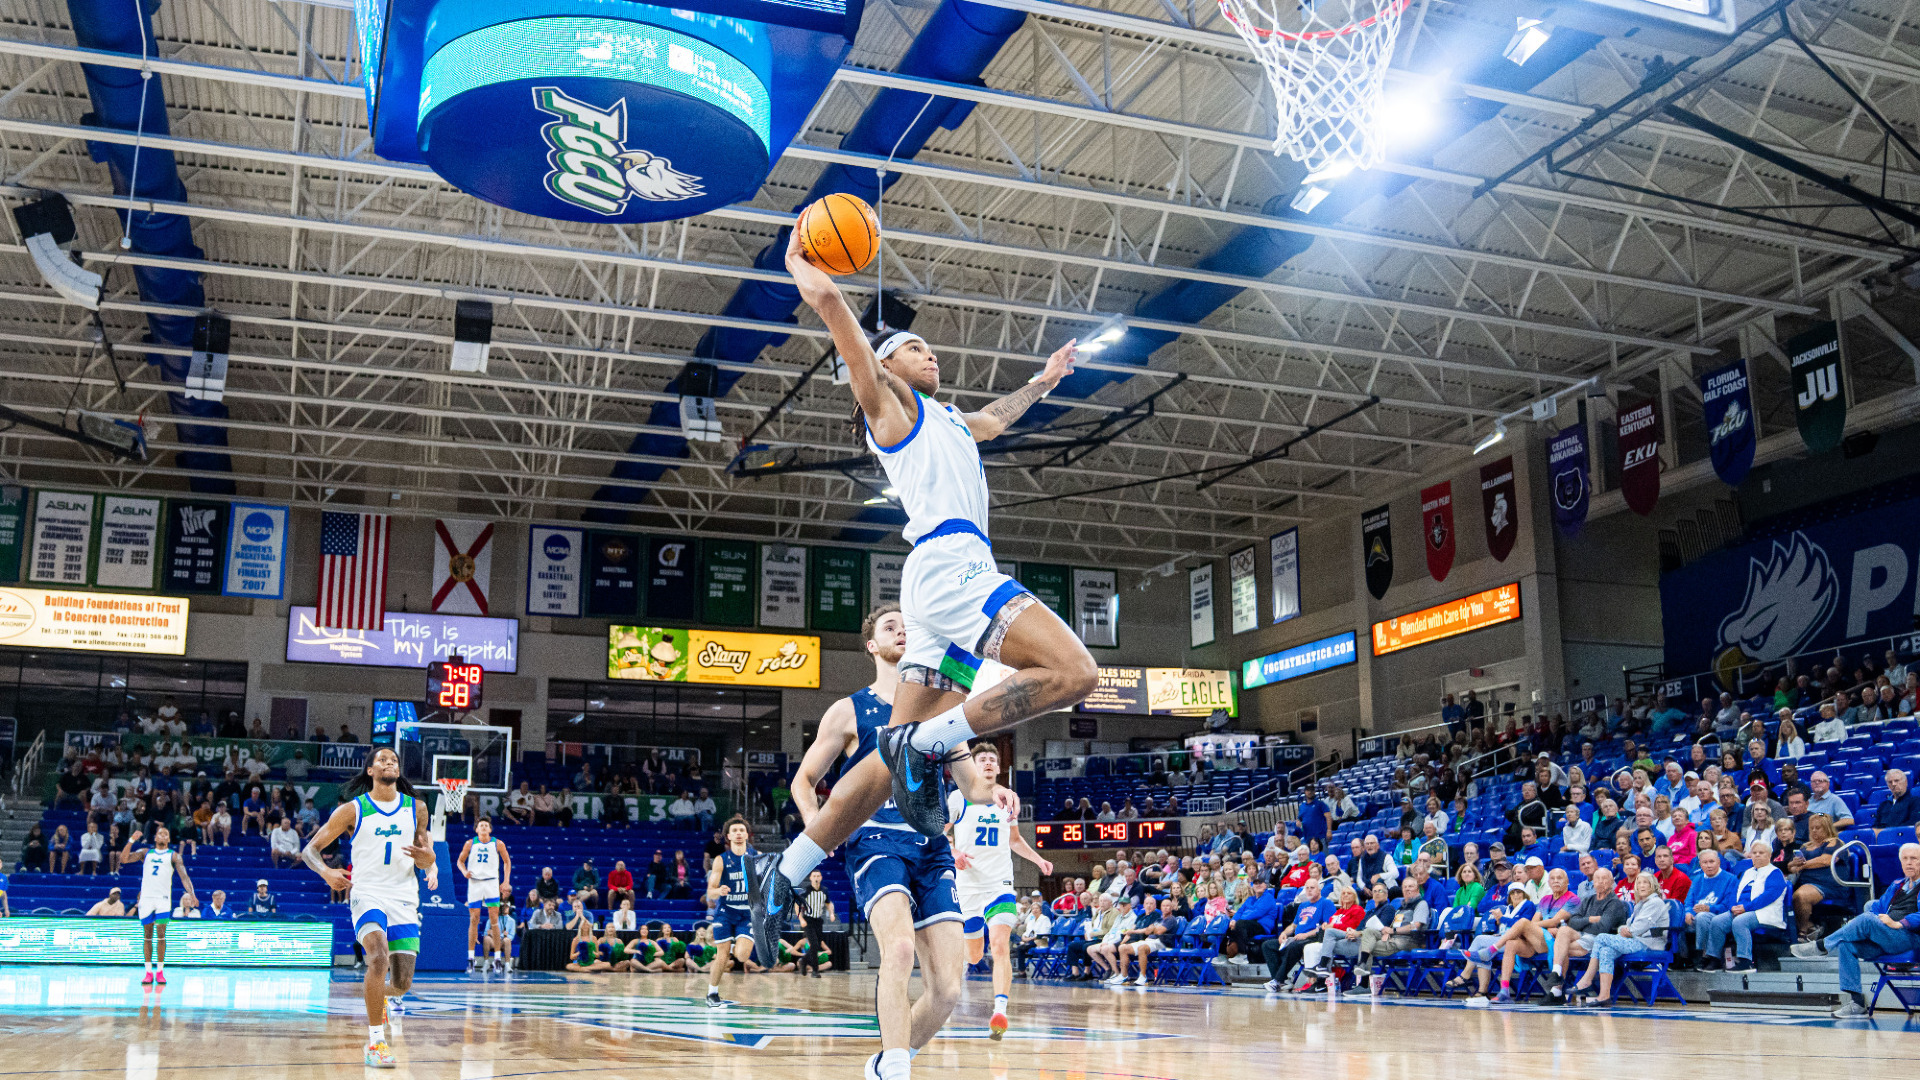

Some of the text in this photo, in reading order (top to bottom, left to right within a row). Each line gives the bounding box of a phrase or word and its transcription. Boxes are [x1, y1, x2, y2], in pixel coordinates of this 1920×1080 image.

[532, 86, 628, 215] FGCU
[1791, 340, 1838, 368] JACKSONVILLE
[1708, 368, 1740, 389] FLORIDA
[1798, 363, 1838, 409] JU
[1703, 377, 1747, 403] GULF COAST
[1621, 404, 1652, 425] EASTERN
[1619, 414, 1655, 437] KENTUCKY
[1709, 409, 1748, 446] FGCU
[1551, 434, 1579, 452] CENTRAL
[1549, 443, 1583, 464] ARKANSAS
[1624, 441, 1657, 466] EKU
[1481, 471, 1513, 490] BELLARMINE
[45, 500, 87, 512] ASUN
[112, 506, 152, 516] ASUN
[41, 531, 83, 541] CHAMPIONS
[246, 526, 273, 535] NCAA
[107, 537, 149, 546] CHAMPIONS
[241, 544, 272, 553] WOMEN'S
[235, 551, 276, 561] BASKETBALL
[237, 569, 271, 578] FINALIST
[242, 580, 266, 591] 2007
[1081, 580, 1111, 589] ASUN
[45, 595, 180, 614] Building Foundations of Trust
[64, 610, 107, 624] Concrete
[109, 613, 169, 628] Construction
[1401, 617, 1428, 637] Blended
[1428, 612, 1443, 630] with
[1443, 608, 1459, 625] Care
[1459, 604, 1470, 621] for
[1470, 600, 1484, 617] You
[384, 618, 431, 638] This
[443, 621, 459, 640] is
[329, 643, 363, 653] Healthcare
[394, 634, 515, 664] my hospital.
[698, 640, 751, 674] Starry
[756, 653, 808, 675] FGCU
[1263, 640, 1354, 675] FGCUATHLETICS.COM
[443, 664, 482, 684] 7:48
[1120, 668, 1142, 679] RIDE
[1111, 678, 1138, 687] PRIDE
[1666, 681, 1682, 697] EE
[440, 683, 469, 706] 28
[1181, 681, 1227, 705] EAGLE
[1581, 698, 1596, 713] DD
[336, 746, 355, 758] VV
[1284, 748, 1301, 759] CC
[1365, 740, 1376, 751] DD
[668, 749, 685, 760] AA
[758, 753, 775, 763] BB
[1045, 760, 1060, 770] CC
[978, 814, 1000, 824] Eagles
[375, 824, 402, 838] Eagles
[975, 826, 999, 847] 20
[1037, 825, 1051, 834] FGCU
[1063, 824, 1082, 841] 26
[1095, 822, 1127, 840] 7:48
[1138, 822, 1153, 839] 17
[384, 841, 393, 865] 1
[477, 853, 489, 864] 32
[152, 866, 160, 876] 2
[735, 880, 746, 893] 11
